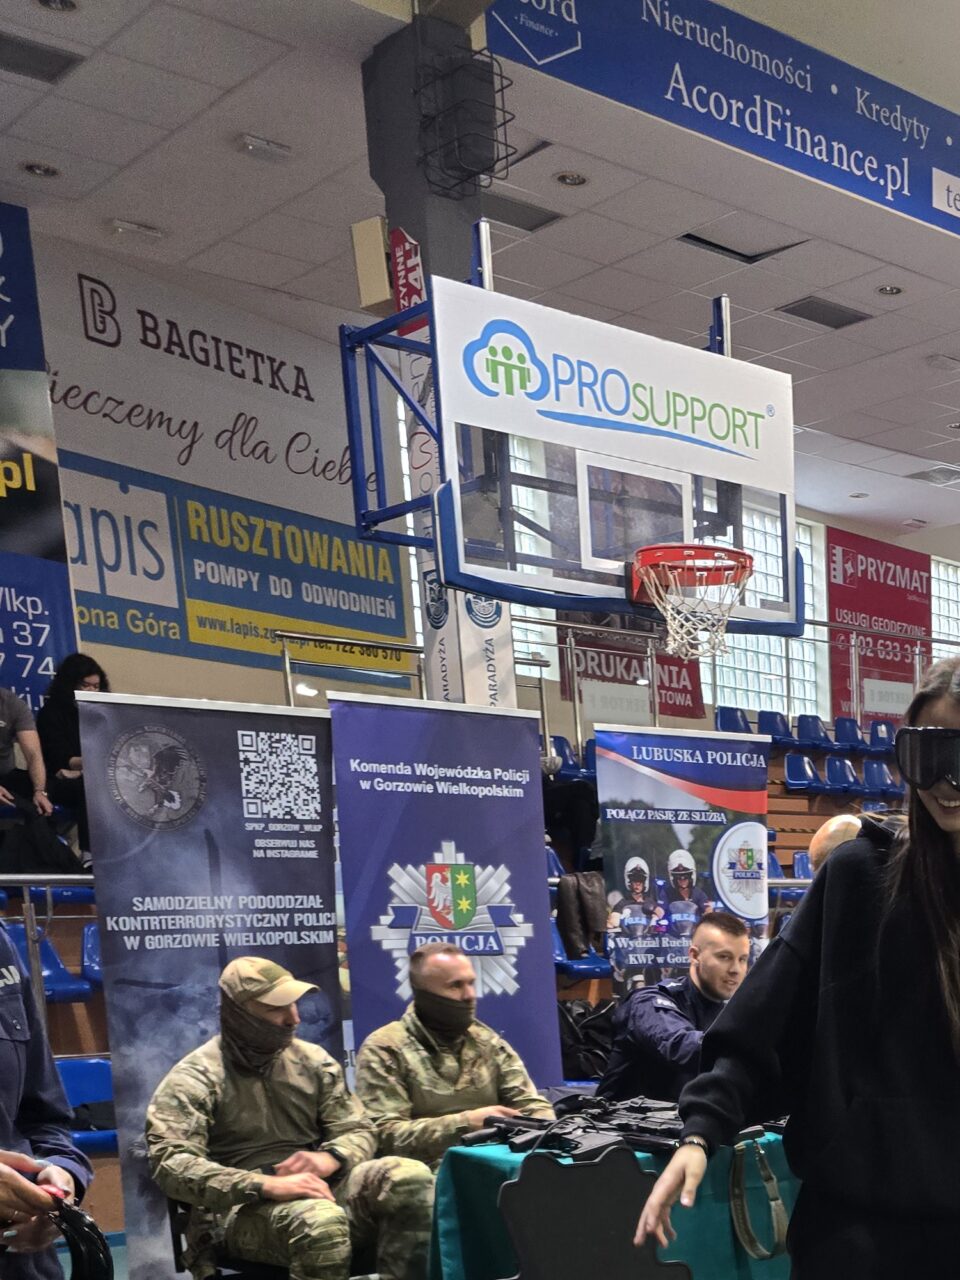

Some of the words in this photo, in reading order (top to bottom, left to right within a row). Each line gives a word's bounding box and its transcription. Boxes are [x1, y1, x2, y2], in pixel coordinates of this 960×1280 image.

[642, 0, 813, 94] Nieruchomości
[855, 86, 931, 150] Kredyty
[664, 62, 912, 201] AcordFinance.pl
[137, 308, 316, 403] BAGIETKA
[552, 352, 766, 451] PROSUPPORT
[48, 370, 205, 467] ieczemy
[214, 412, 278, 464] dla
[284, 430, 381, 494] Ciebe
[63, 480, 167, 596] apis
[186, 499, 396, 586] RUSZTOWANIA
[857, 554, 930, 595] PRYZMAT
[193, 558, 261, 594] POMPY
[269, 574, 293, 599] DO
[301, 581, 397, 620] ODWODNIEŃ
[0, 587, 50, 620] lkp.
[126, 609, 182, 641] Góra
[835, 607, 870, 630] USŁUGI
[12, 620, 51, 648] 37
[877, 639, 902, 663] 633
[16, 652, 58, 681] 74
[439, 636, 451, 702] ARADYŻA
[659, 689, 694, 708] TOWA
[350, 758, 412, 776] Komenda
[413, 763, 492, 781] Wojewódzka
[493, 767, 531, 784] Policji
[631, 745, 705, 765] LUBUSKA
[706, 751, 768, 769] POLICJA
[359, 780, 371, 791] w
[373, 778, 435, 794] Gorzowie
[436, 780, 525, 799] Wielkopolskim
[677, 811, 690, 822] ZE
[131, 894, 234, 912] SAMODZIELNY
[237, 893, 325, 910] PODODDZIAŁ
[105, 912, 290, 932] KONTRTERRORYSTYCZNY
[123, 934, 141, 951] W
[144, 932, 221, 950] GORZOWIE
[222, 929, 335, 947] WIELKOPOLSKIM
[414, 934, 501, 952] POLICJA
[666, 952, 692, 965] Gorz
